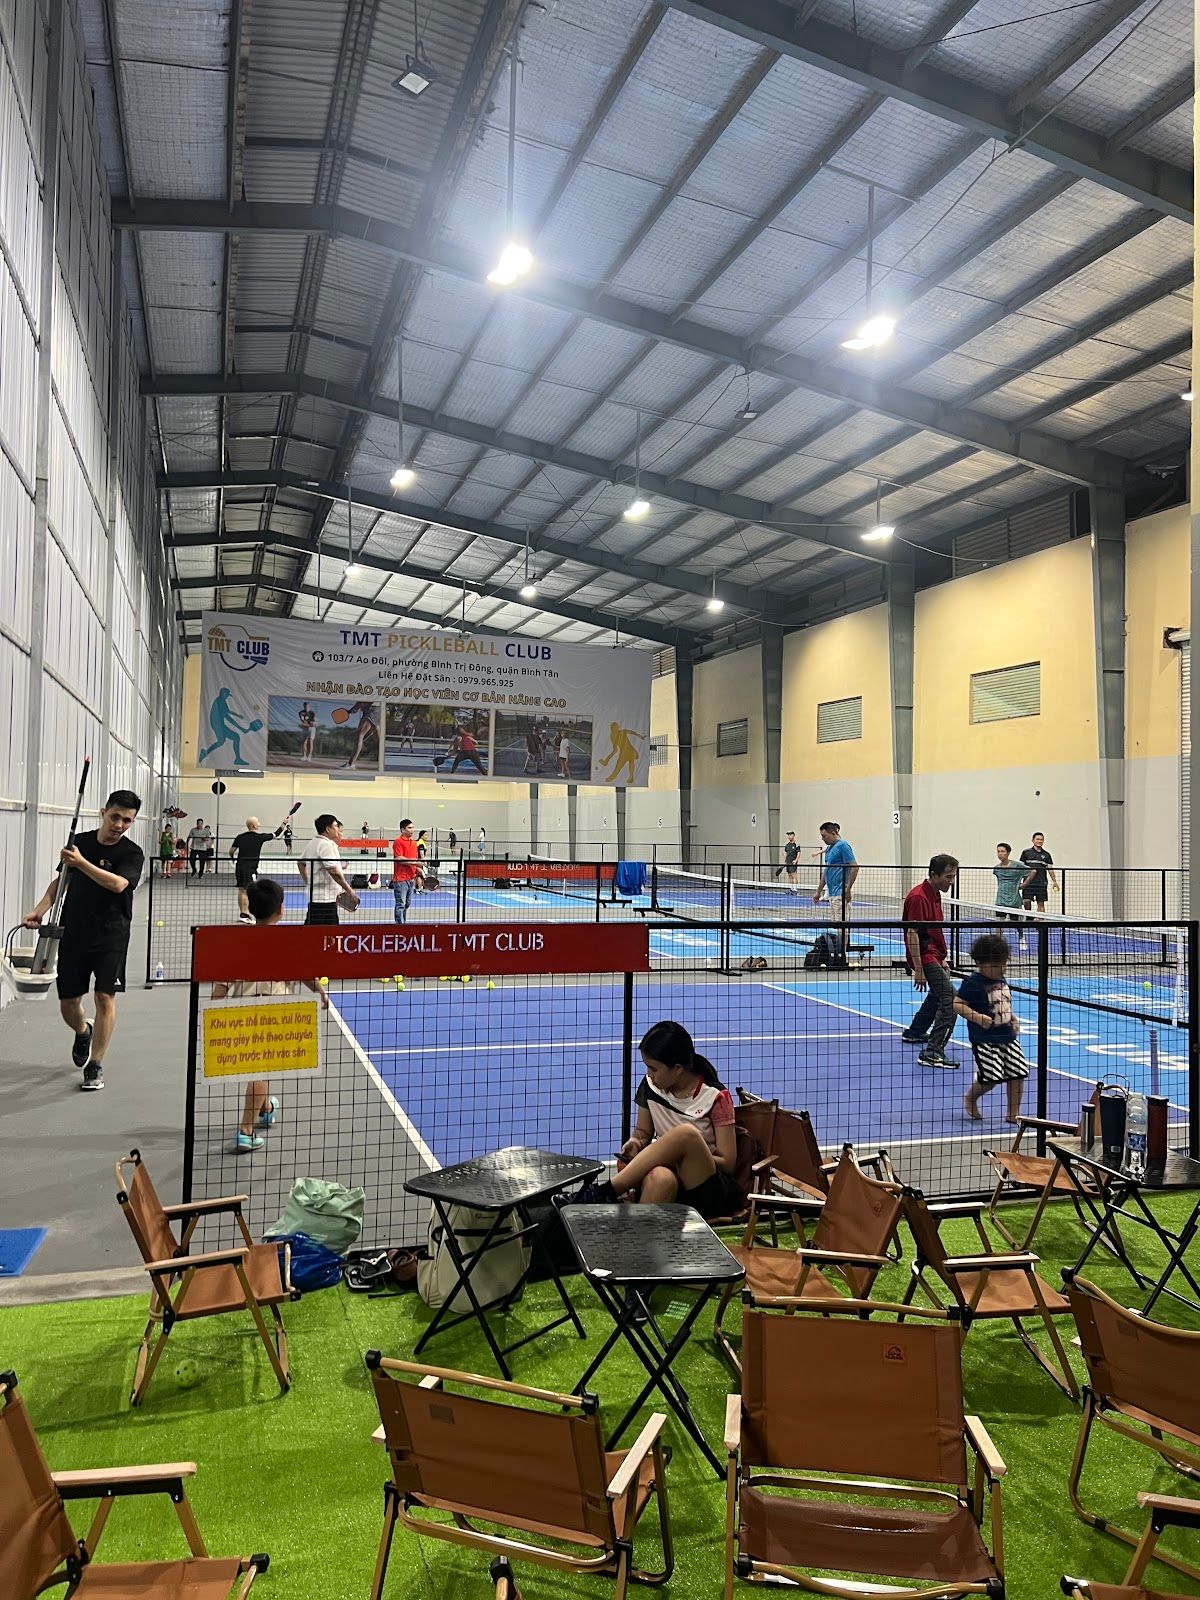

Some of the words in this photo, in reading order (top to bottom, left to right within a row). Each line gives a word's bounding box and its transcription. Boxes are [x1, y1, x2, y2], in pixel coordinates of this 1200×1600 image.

[207, 637, 232, 652] TMT
[237, 640, 270, 656] CLUB
[340, 630, 382, 647] TMT
[388, 633, 499, 656] PICKLEBALL
[505, 643, 552, 660] CLUB
[328, 653, 354, 663] 103/7
[356, 656, 369, 664] Ao
[392, 658, 429, 670] phường
[431, 660, 452, 669] Bình
[454, 662, 466, 672] Trị
[496, 666, 519, 676] quận
[521, 667, 541, 677] Bình
[543, 669, 559, 678] Tân
[378, 671, 398, 680] Liên
[401, 671, 413, 682] Hệ
[416, 673, 432, 684] Đặt
[458, 676, 514, 688] 0979.965.925
[306, 681, 344, 695] NHẬN
[346, 682, 373, 695] ĐÀO
[376, 685, 401, 698] TẠO
[403, 687, 429, 700] HỌC
[462, 691, 479, 702] CƠ
[481, 690, 506, 704] BẢN
[508, 694, 541, 707] NÂNG
[543, 697, 567, 708] CAO
[893, 813, 899, 825] 3
[323, 934, 442, 954] PICKLEBALL
[447, 933, 490, 952] TMT
[495, 932, 545, 951] CLUB
[210, 1018, 227, 1030] Khu
[229, 1019, 244, 1031] vực
[246, 1013, 258, 1027] thể
[260, 1014, 279, 1027] thao,
[281, 1012, 293, 1024] vui
[209, 1037, 231, 1048] mang
[252, 1030, 264, 1043] thể
[266, 1031, 284, 1042] thao
[217, 1053, 237, 1066] dụng
[239, 1049, 261, 1061] trước
[262, 1049, 275, 1060] khi
